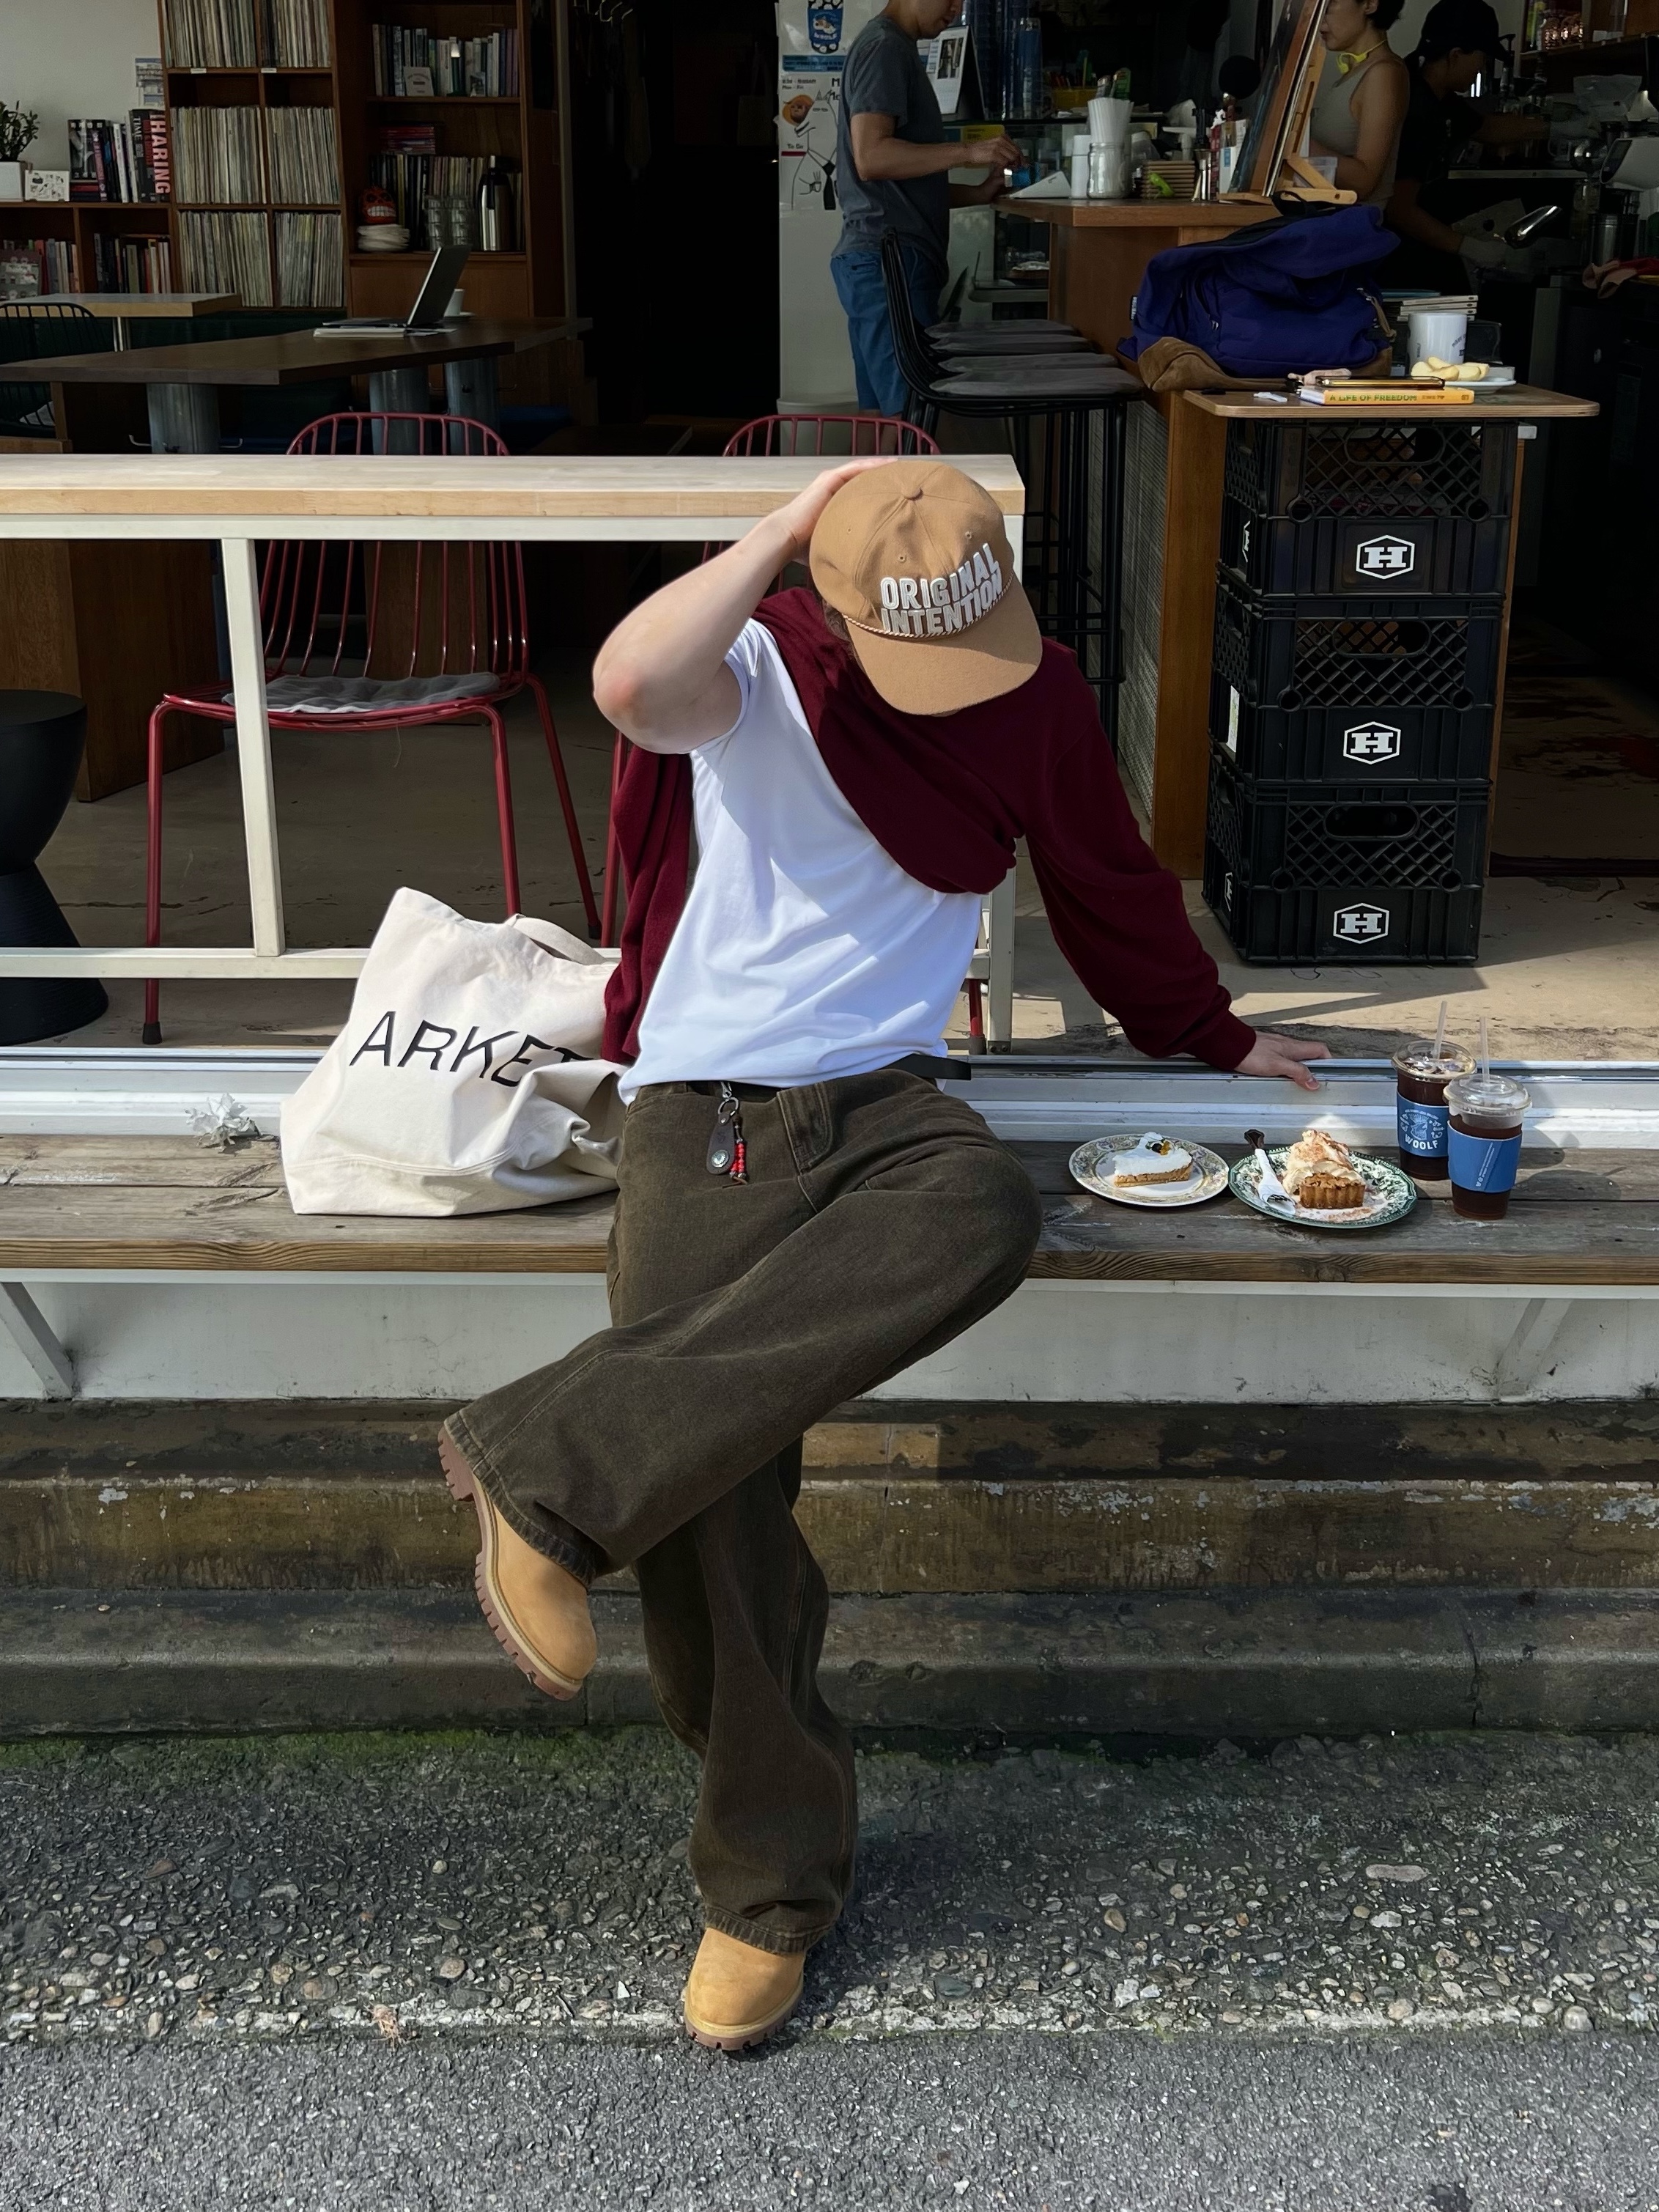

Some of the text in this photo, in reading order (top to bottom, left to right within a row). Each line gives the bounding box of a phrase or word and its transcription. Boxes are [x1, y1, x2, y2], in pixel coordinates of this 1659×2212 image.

[880, 542, 1001, 610] ORIGINAL
[881, 569, 1002, 635] INTENTION
[1404, 1135, 1438, 1150] WOOLF
